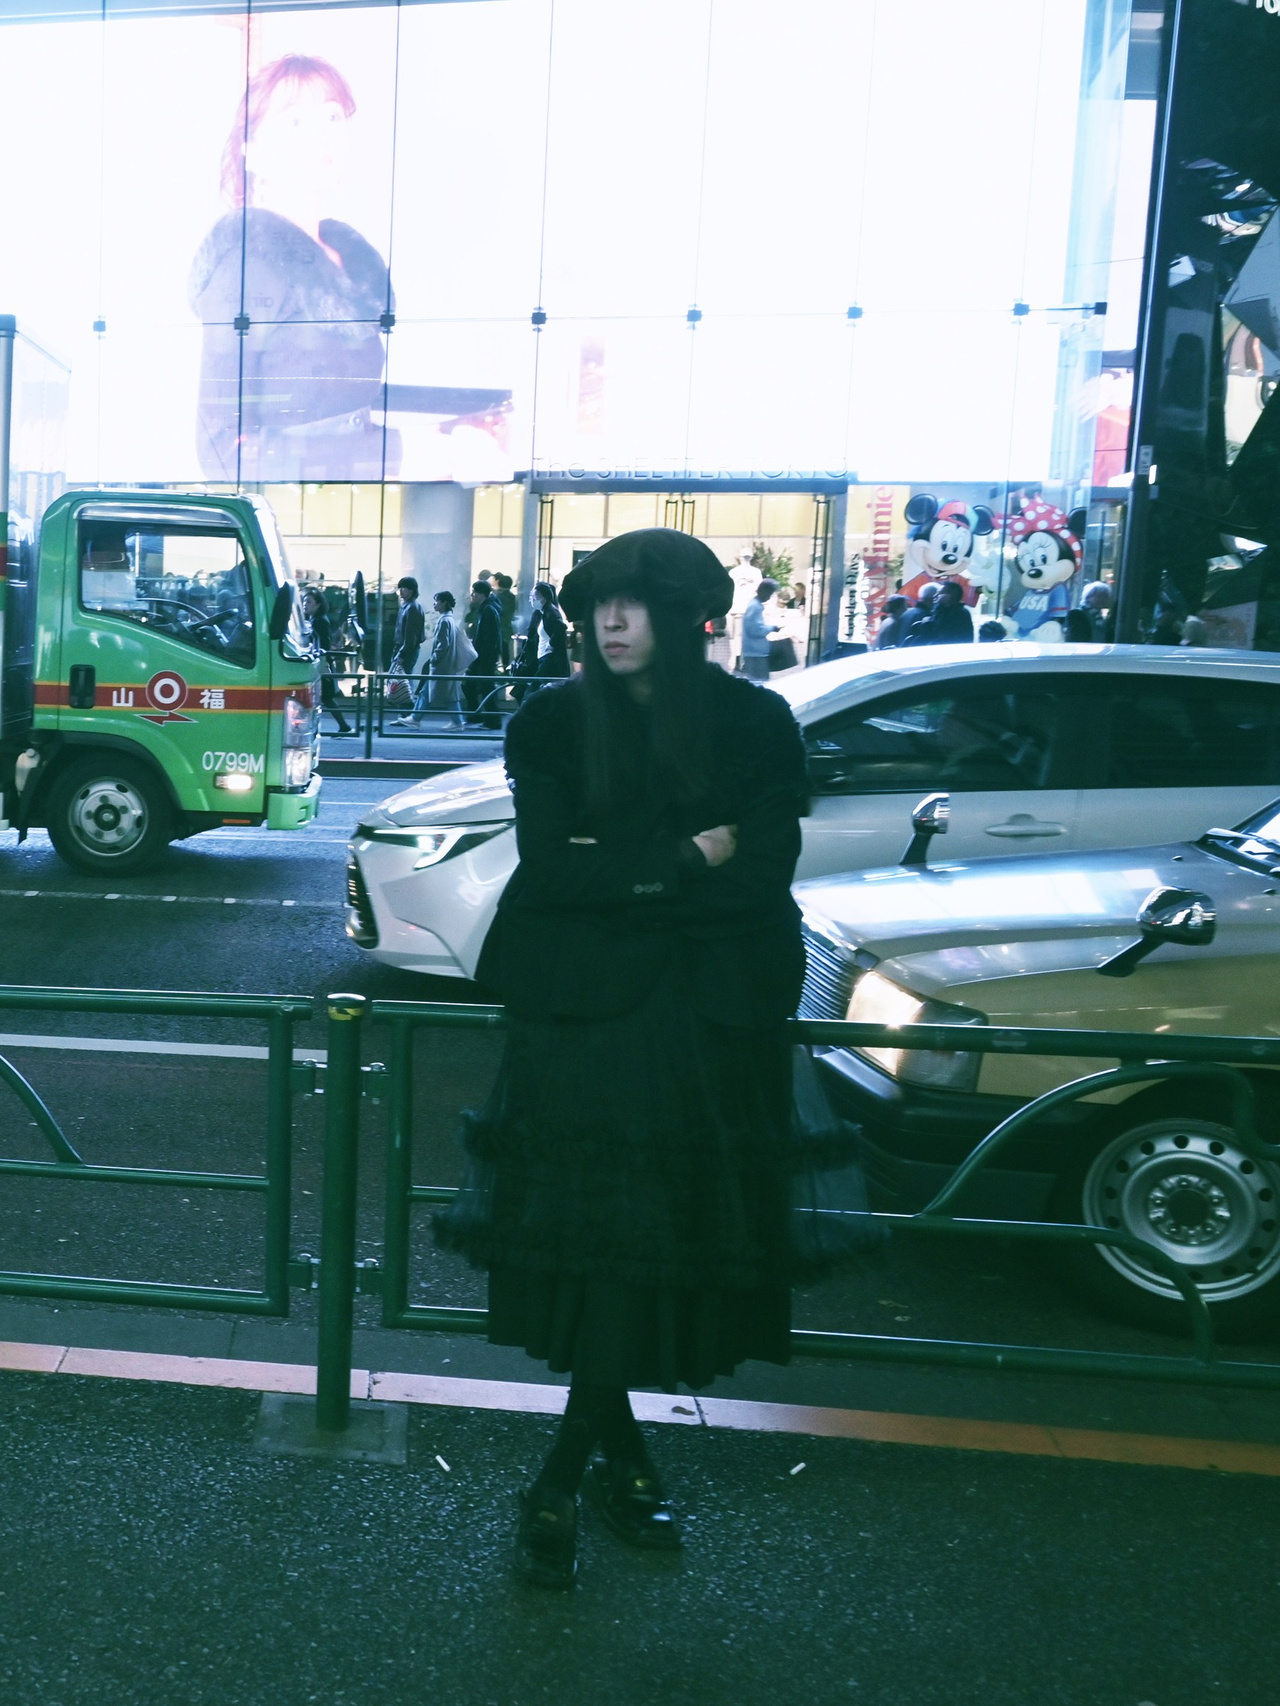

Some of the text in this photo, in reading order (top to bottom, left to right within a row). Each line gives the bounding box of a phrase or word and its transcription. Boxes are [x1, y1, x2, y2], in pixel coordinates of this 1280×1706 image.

[1019, 595, 1049, 612] USA
[112, 687, 225, 710] 山 福
[202, 751, 265, 774] 0799M
